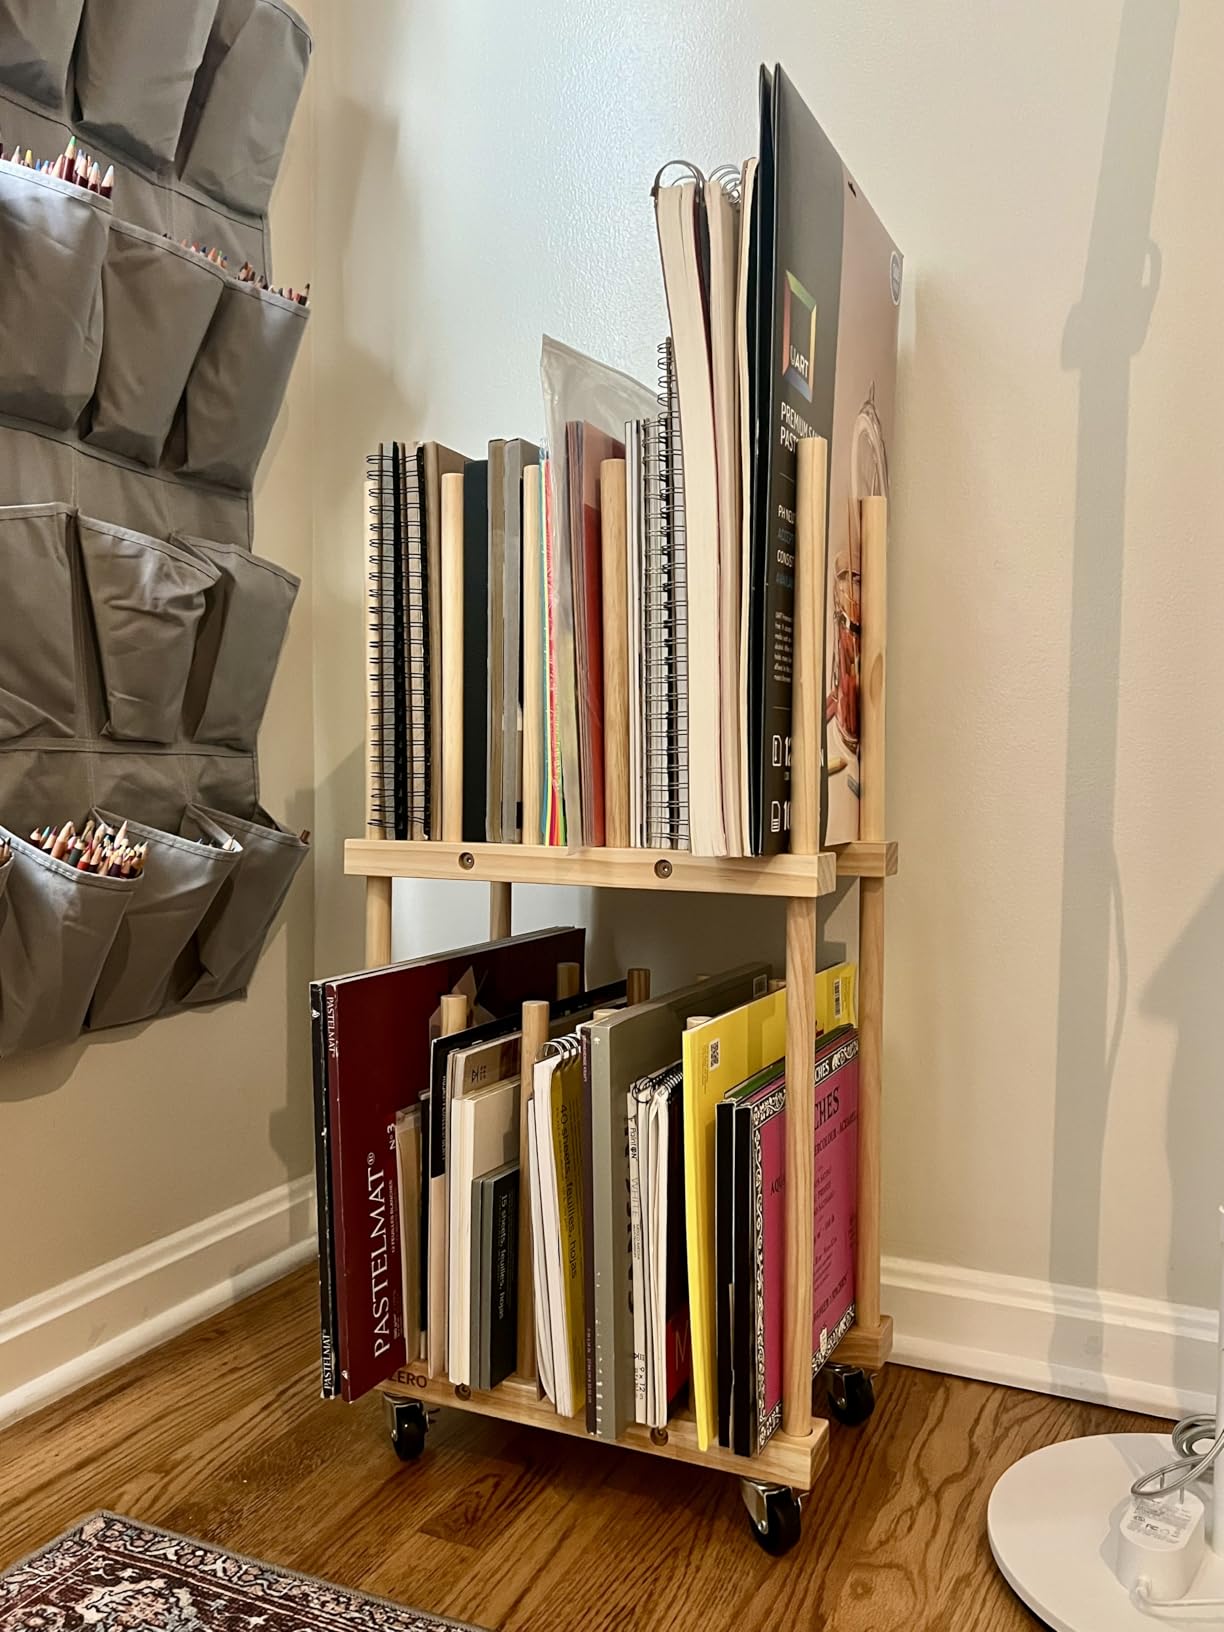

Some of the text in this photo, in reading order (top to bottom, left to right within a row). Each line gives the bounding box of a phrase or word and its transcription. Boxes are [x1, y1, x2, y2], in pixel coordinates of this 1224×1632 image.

[790, 344, 809, 378] UART
[780, 401, 808, 439] PREMIUM
[560, 1104, 579, 1280] 40 sheets, feuilles, hojas
[631, 1177, 641, 1217] WHITE
[639, 1383, 646, 1393] 12
